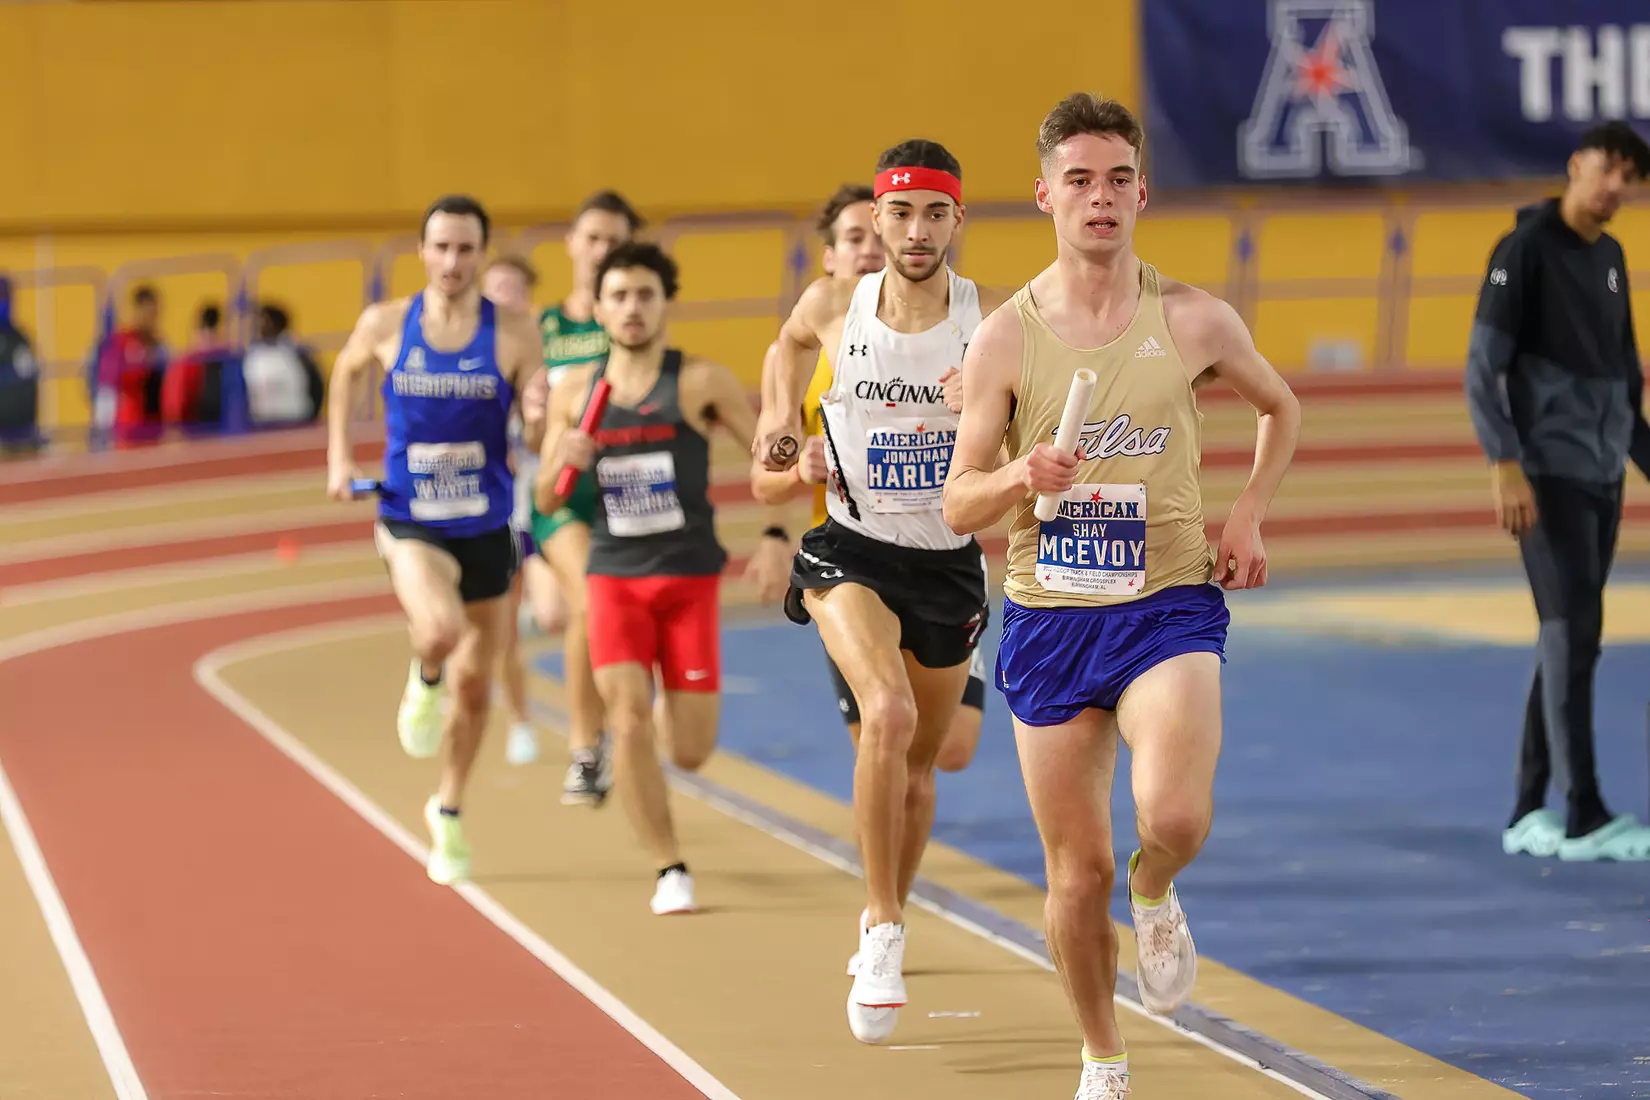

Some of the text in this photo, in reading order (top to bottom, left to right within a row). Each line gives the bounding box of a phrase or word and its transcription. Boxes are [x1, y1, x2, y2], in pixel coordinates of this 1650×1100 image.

[1135, 349, 1166, 358] adidas
[855, 380, 945, 404] CINCINNA
[882, 447, 949, 464] JONATHAN
[868, 461, 951, 488] HARLE
[1057, 501, 1139, 518] MERICAN
[1073, 523, 1107, 538] SHAY
[1039, 534, 1145, 567] MCEVOY
